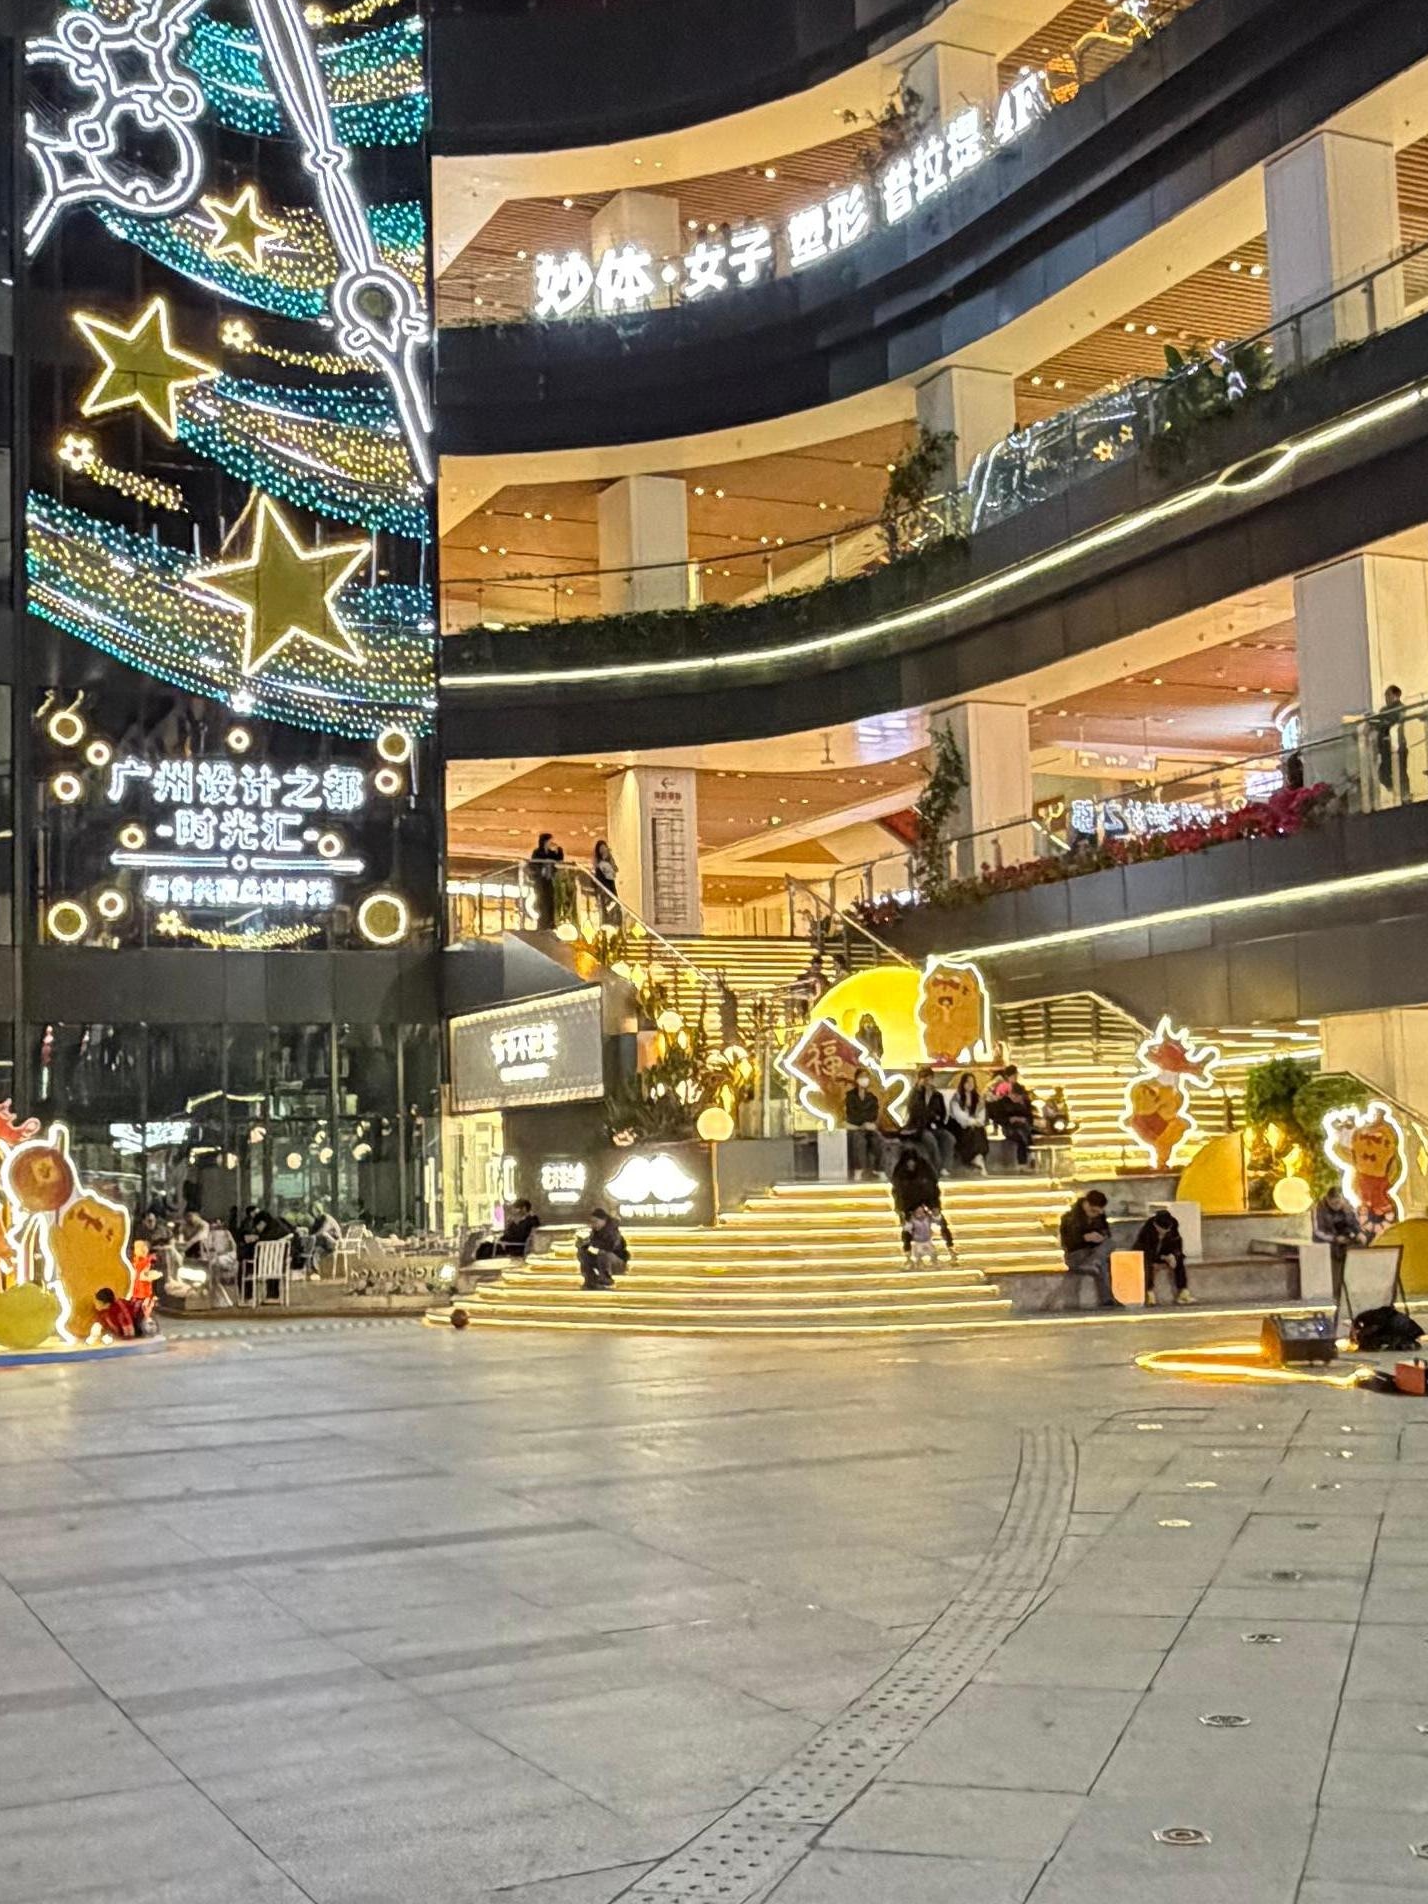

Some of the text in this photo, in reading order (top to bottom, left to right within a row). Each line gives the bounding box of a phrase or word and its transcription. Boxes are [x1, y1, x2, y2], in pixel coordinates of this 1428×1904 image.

[788, 184, 870, 268] 塑形
[883, 107, 983, 225] 普拉提
[107, 756, 364, 810] 广州设计之都
